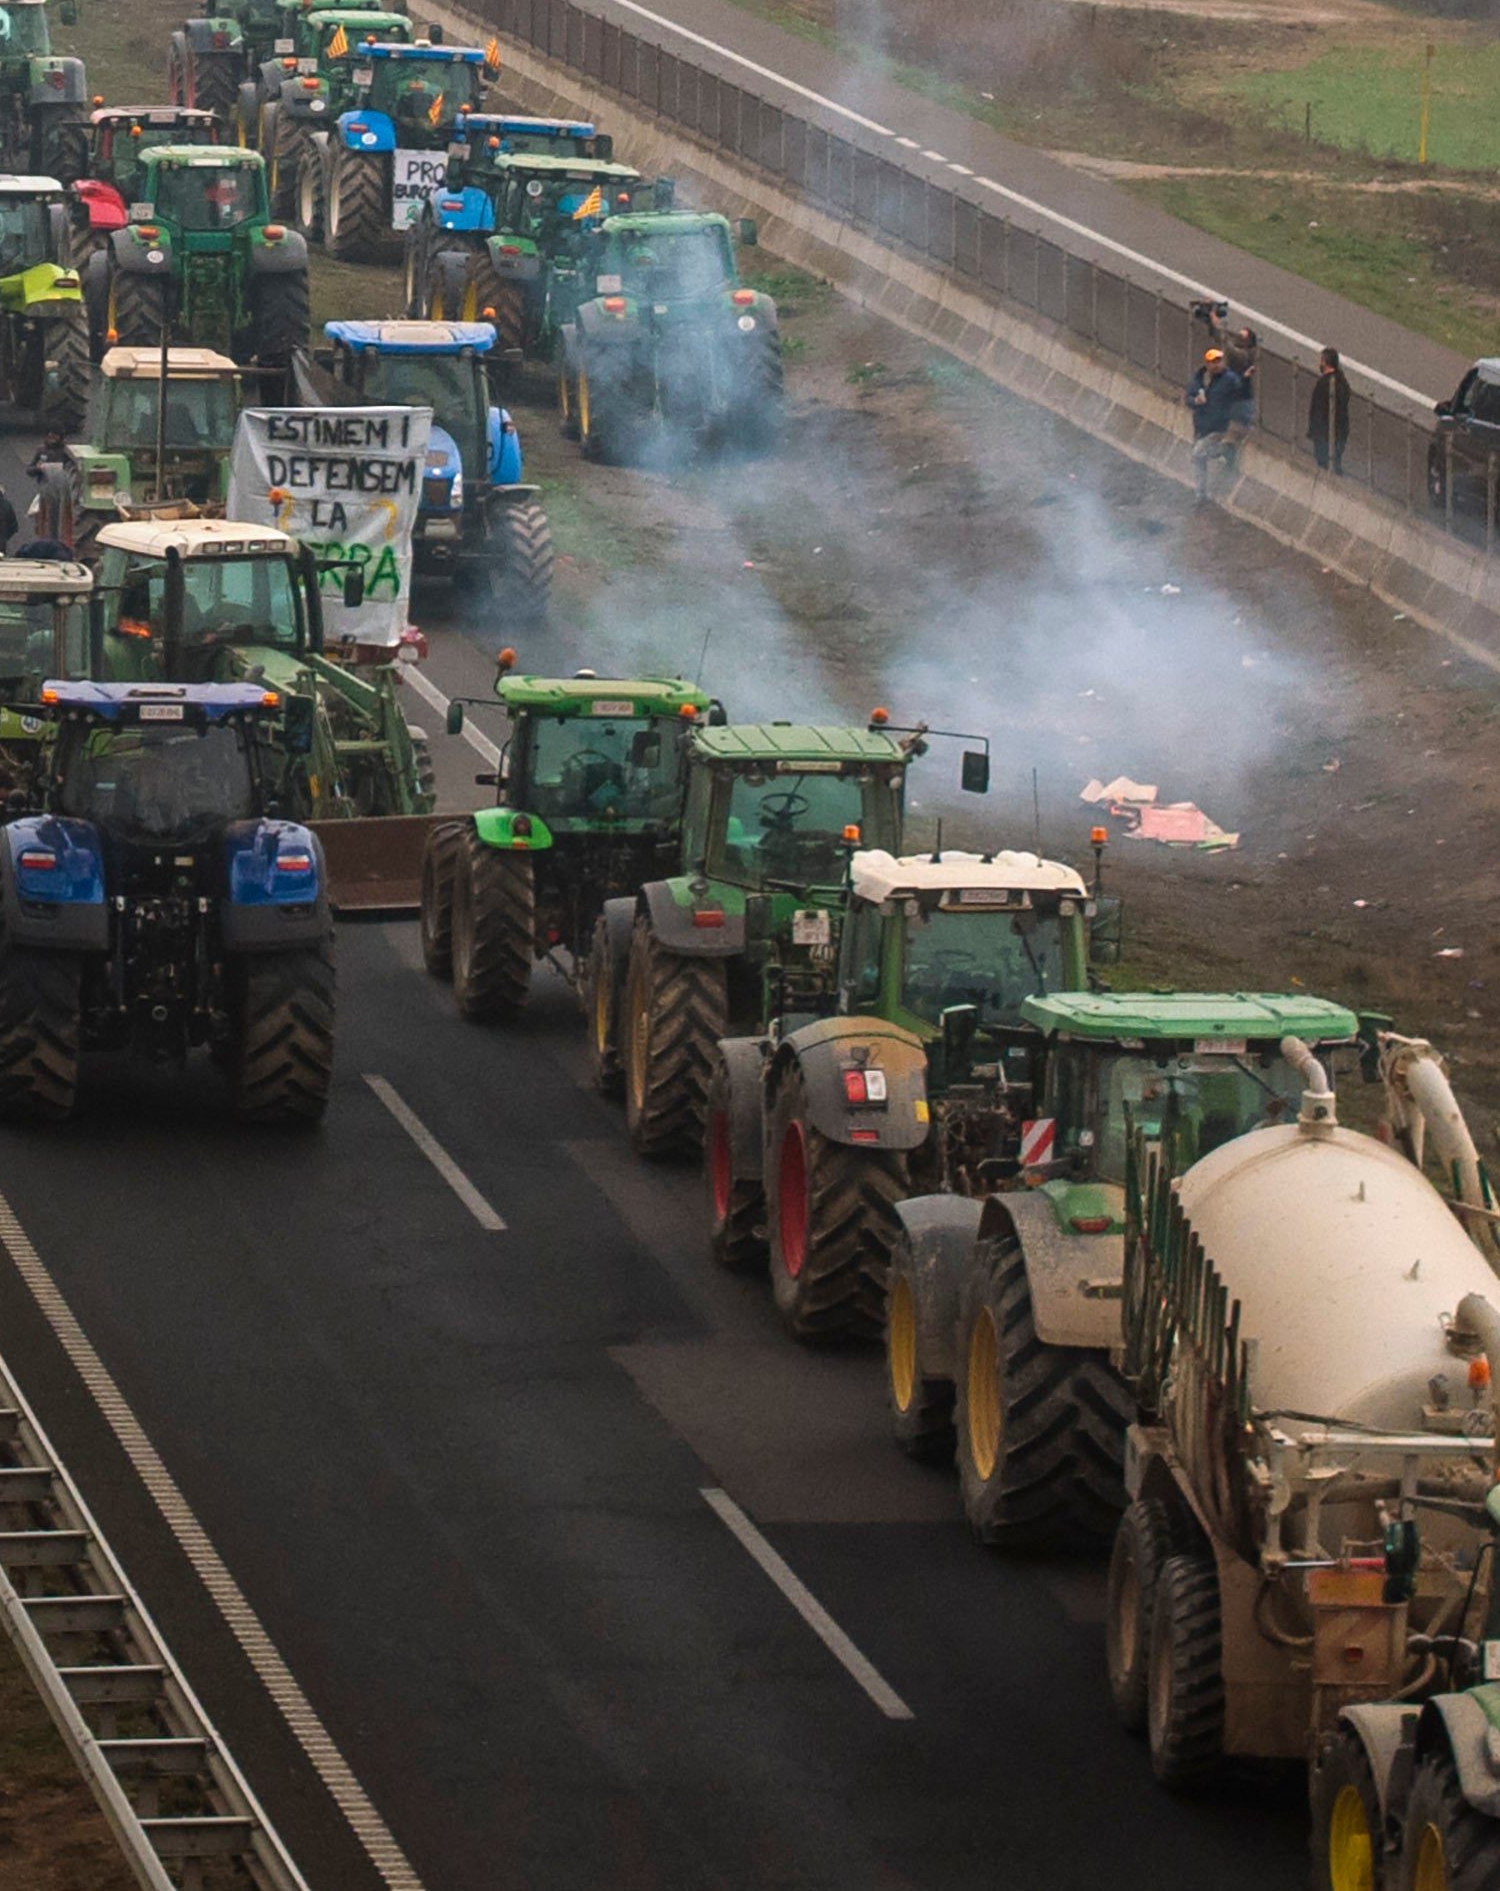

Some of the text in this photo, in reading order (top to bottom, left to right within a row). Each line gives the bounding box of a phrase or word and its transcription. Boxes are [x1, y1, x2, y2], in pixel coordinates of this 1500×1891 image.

[267, 414, 409, 448] ESTIMEM I
[266, 455, 416, 495] DEFENSEM
[312, 499, 347, 532] LA
